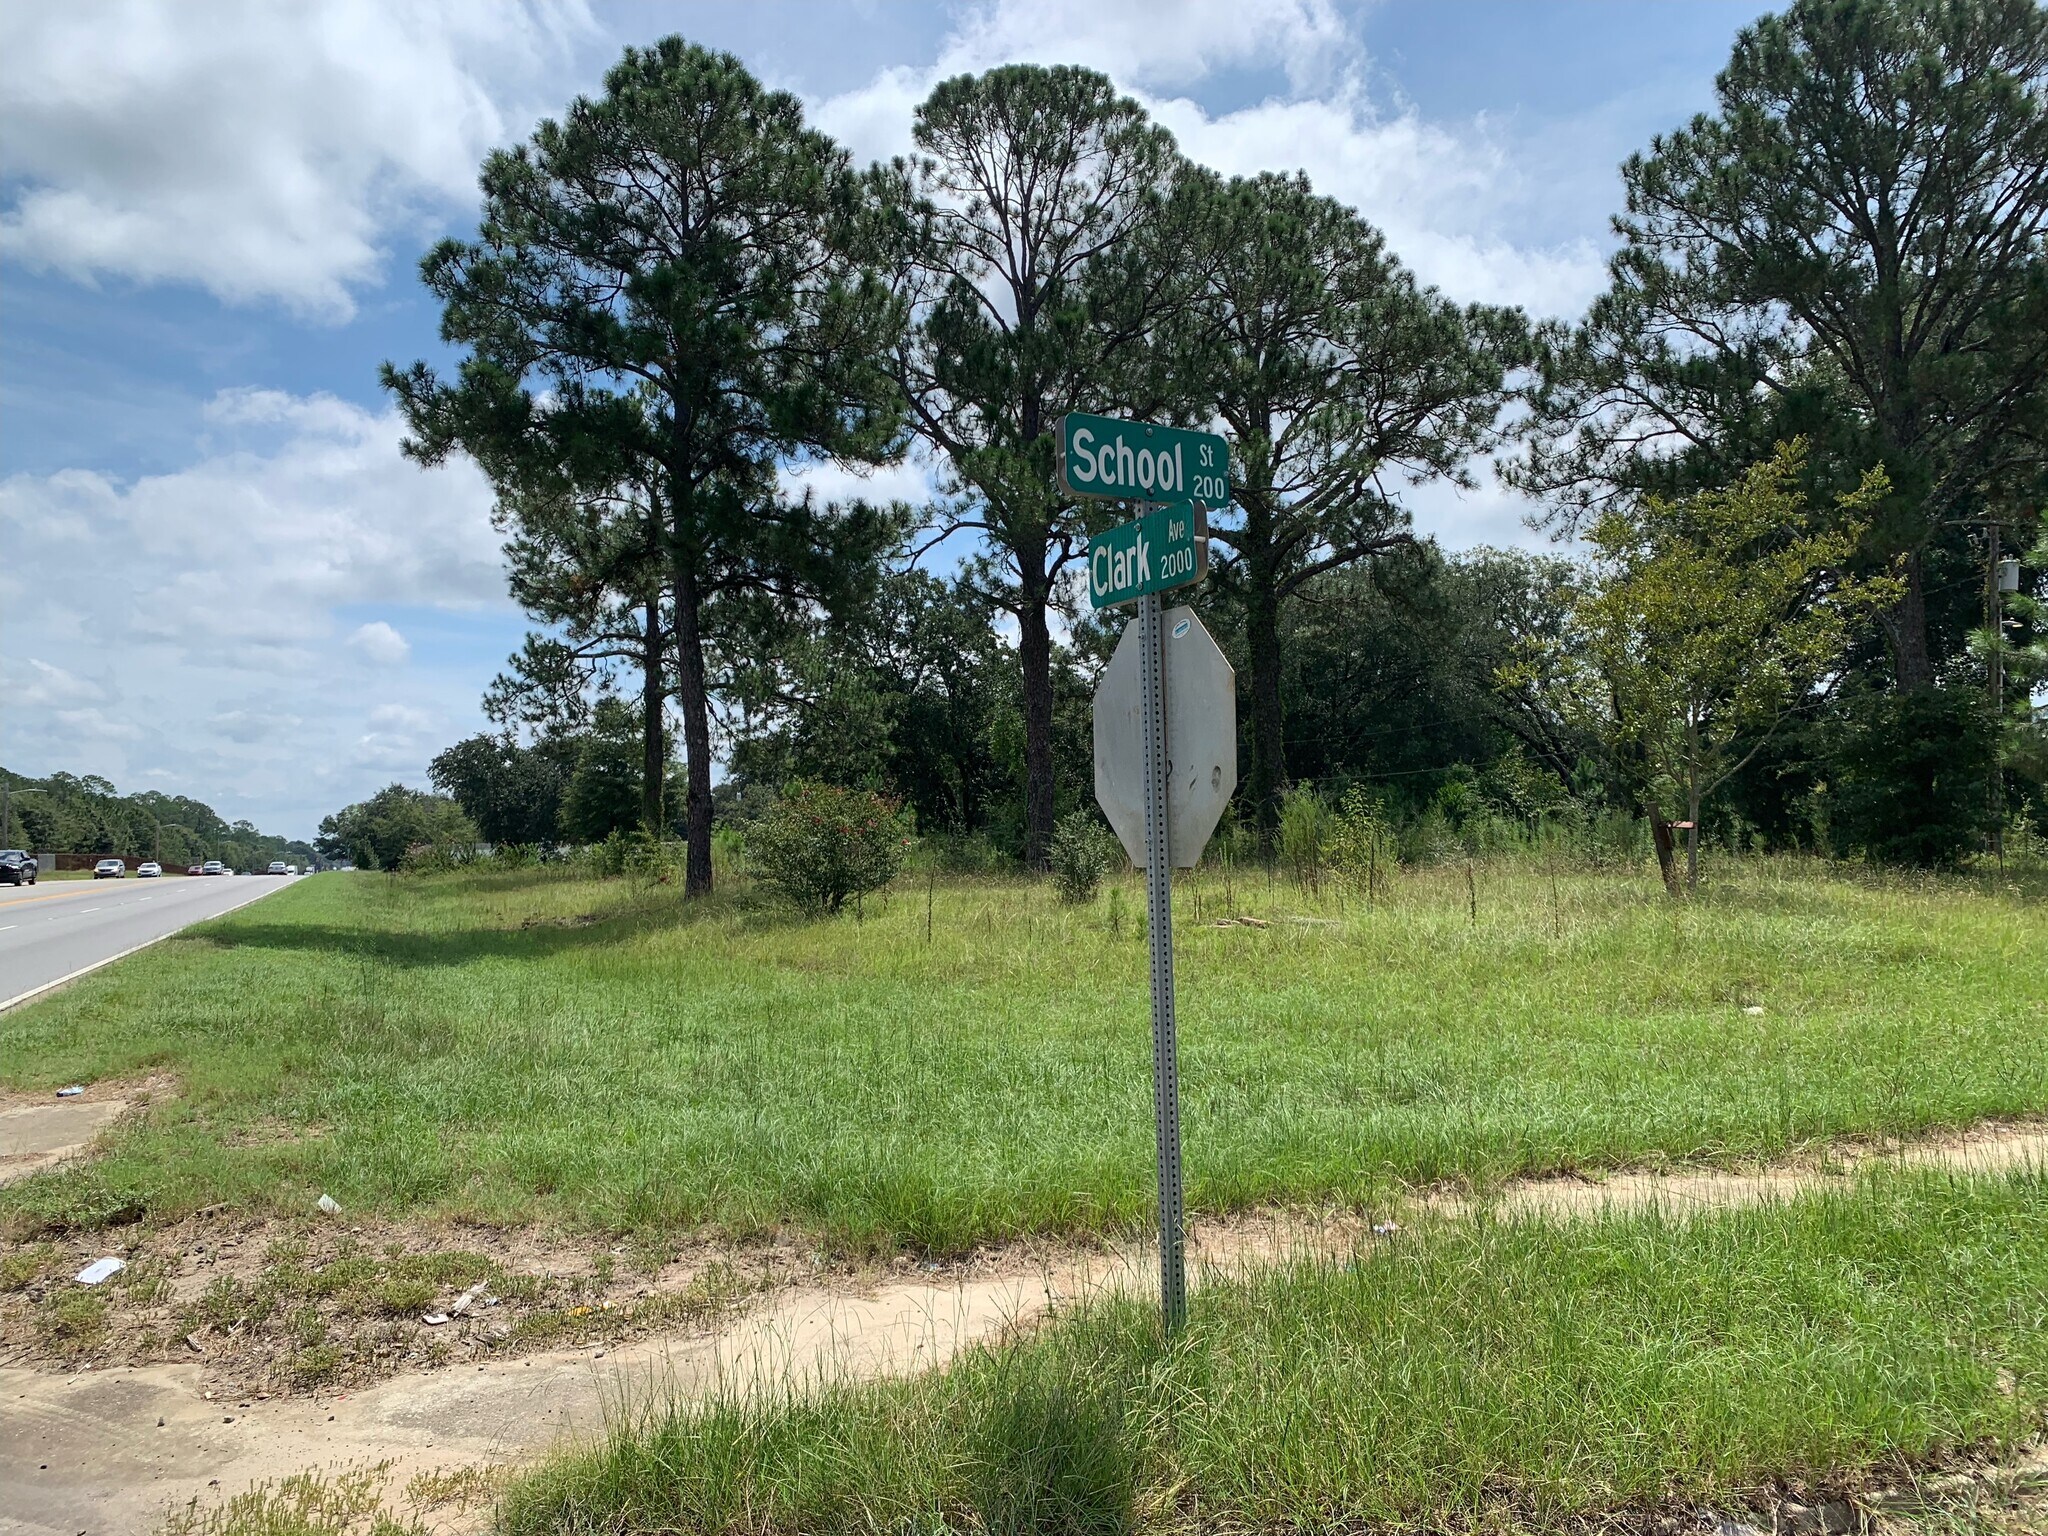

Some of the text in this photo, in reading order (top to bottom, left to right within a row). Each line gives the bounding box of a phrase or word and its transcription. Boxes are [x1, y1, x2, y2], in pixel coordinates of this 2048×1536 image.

[1072, 428, 1213, 492] School St
[1193, 475, 1225, 500] 200
[1092, 519, 1185, 597] Clark Ave
[1160, 547, 1193, 580] 2000
